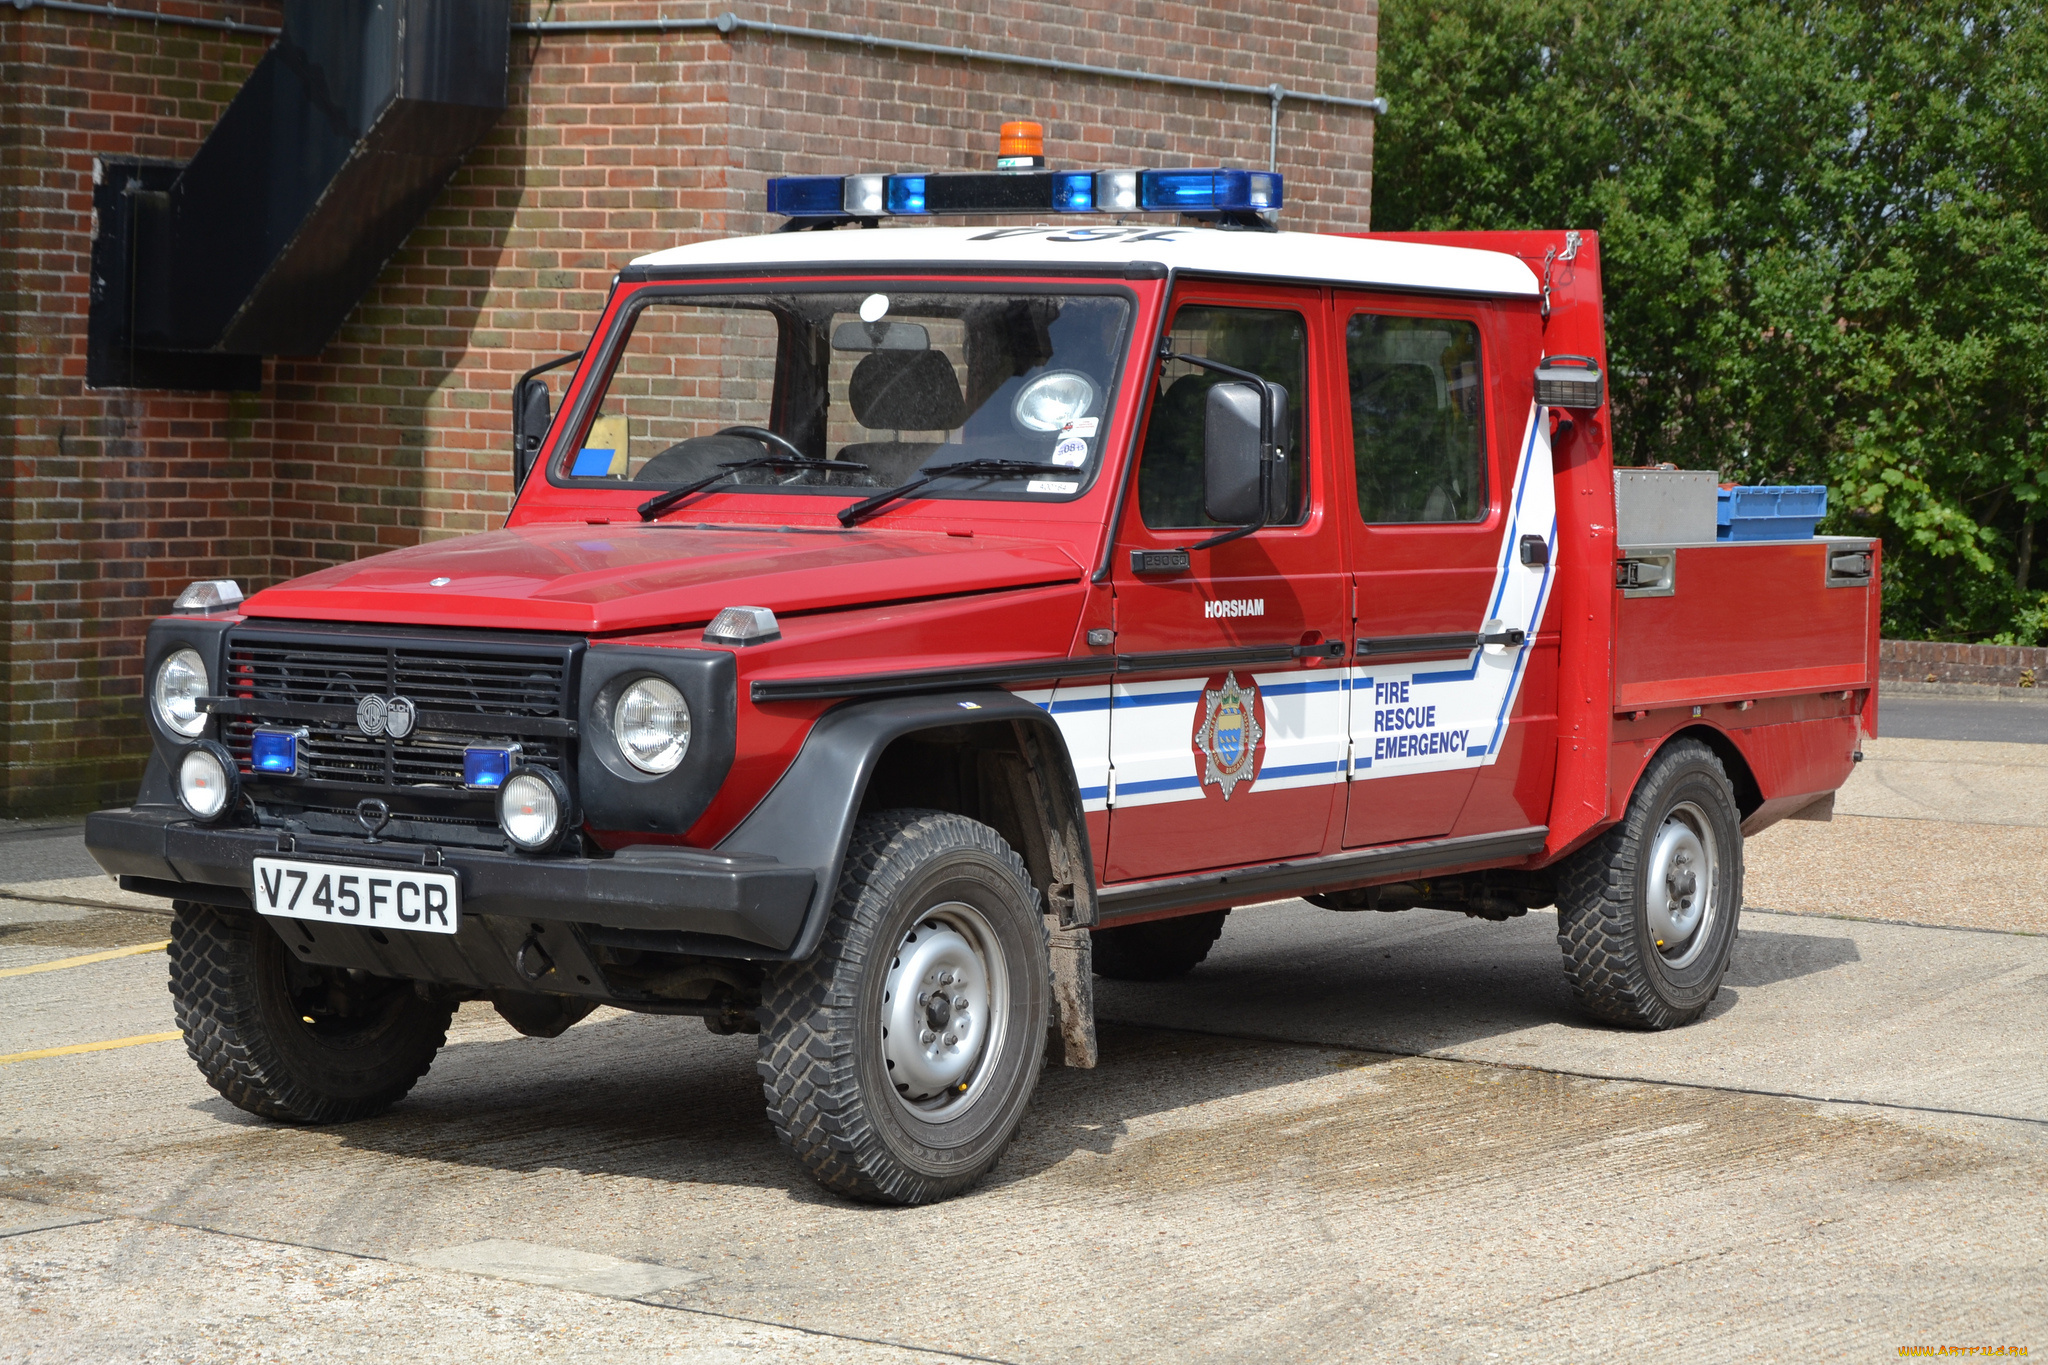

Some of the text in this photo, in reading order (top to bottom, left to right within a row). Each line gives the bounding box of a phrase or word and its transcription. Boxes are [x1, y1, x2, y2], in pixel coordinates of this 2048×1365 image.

[1146, 555, 1169, 566] 290
[1205, 598, 1264, 618] HORSHAM
[1375, 681, 1410, 705] FIRE
[388, 703, 410, 712] PUCH
[1374, 705, 1436, 732] RESCUE
[1374, 729, 1469, 760] EMERGENCY
[260, 867, 449, 927] V745FCR
